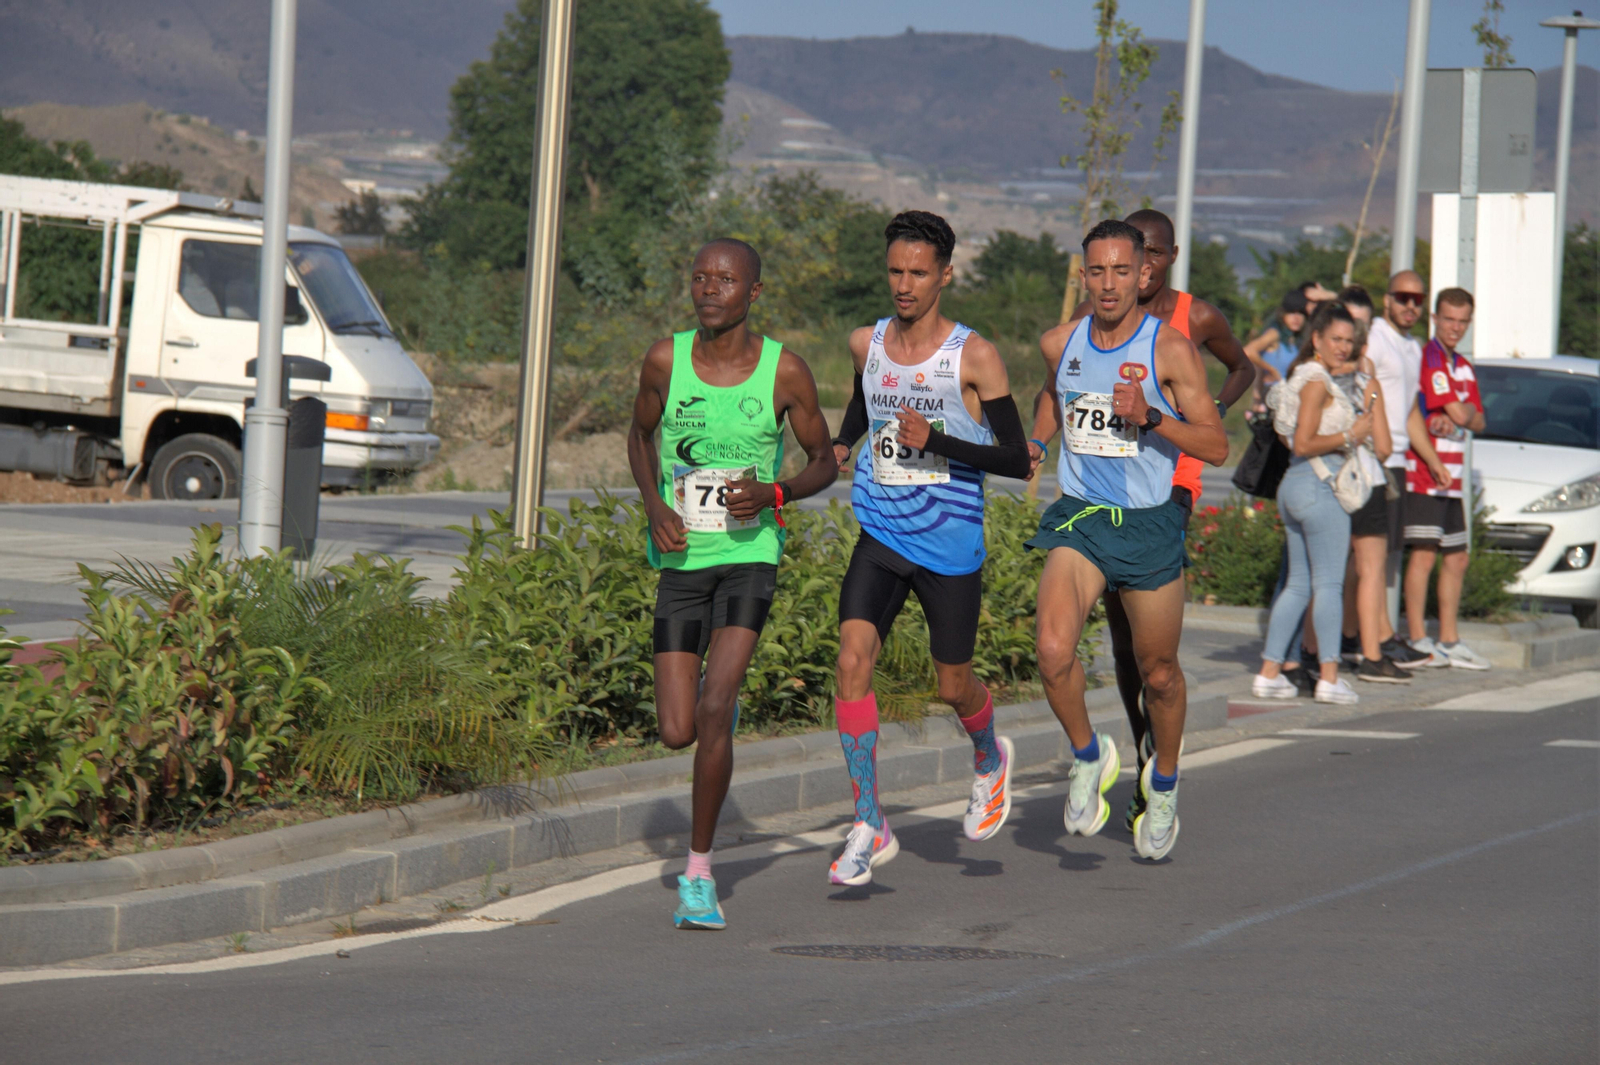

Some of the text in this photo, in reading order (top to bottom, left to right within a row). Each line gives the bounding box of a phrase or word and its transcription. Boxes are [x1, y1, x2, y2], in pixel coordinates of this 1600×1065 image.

[871, 393, 944, 411] MARACENA
[679, 420, 706, 428] UCLM
[1075, 407, 1124, 432] 784
[705, 450, 753, 460] MENORCA
